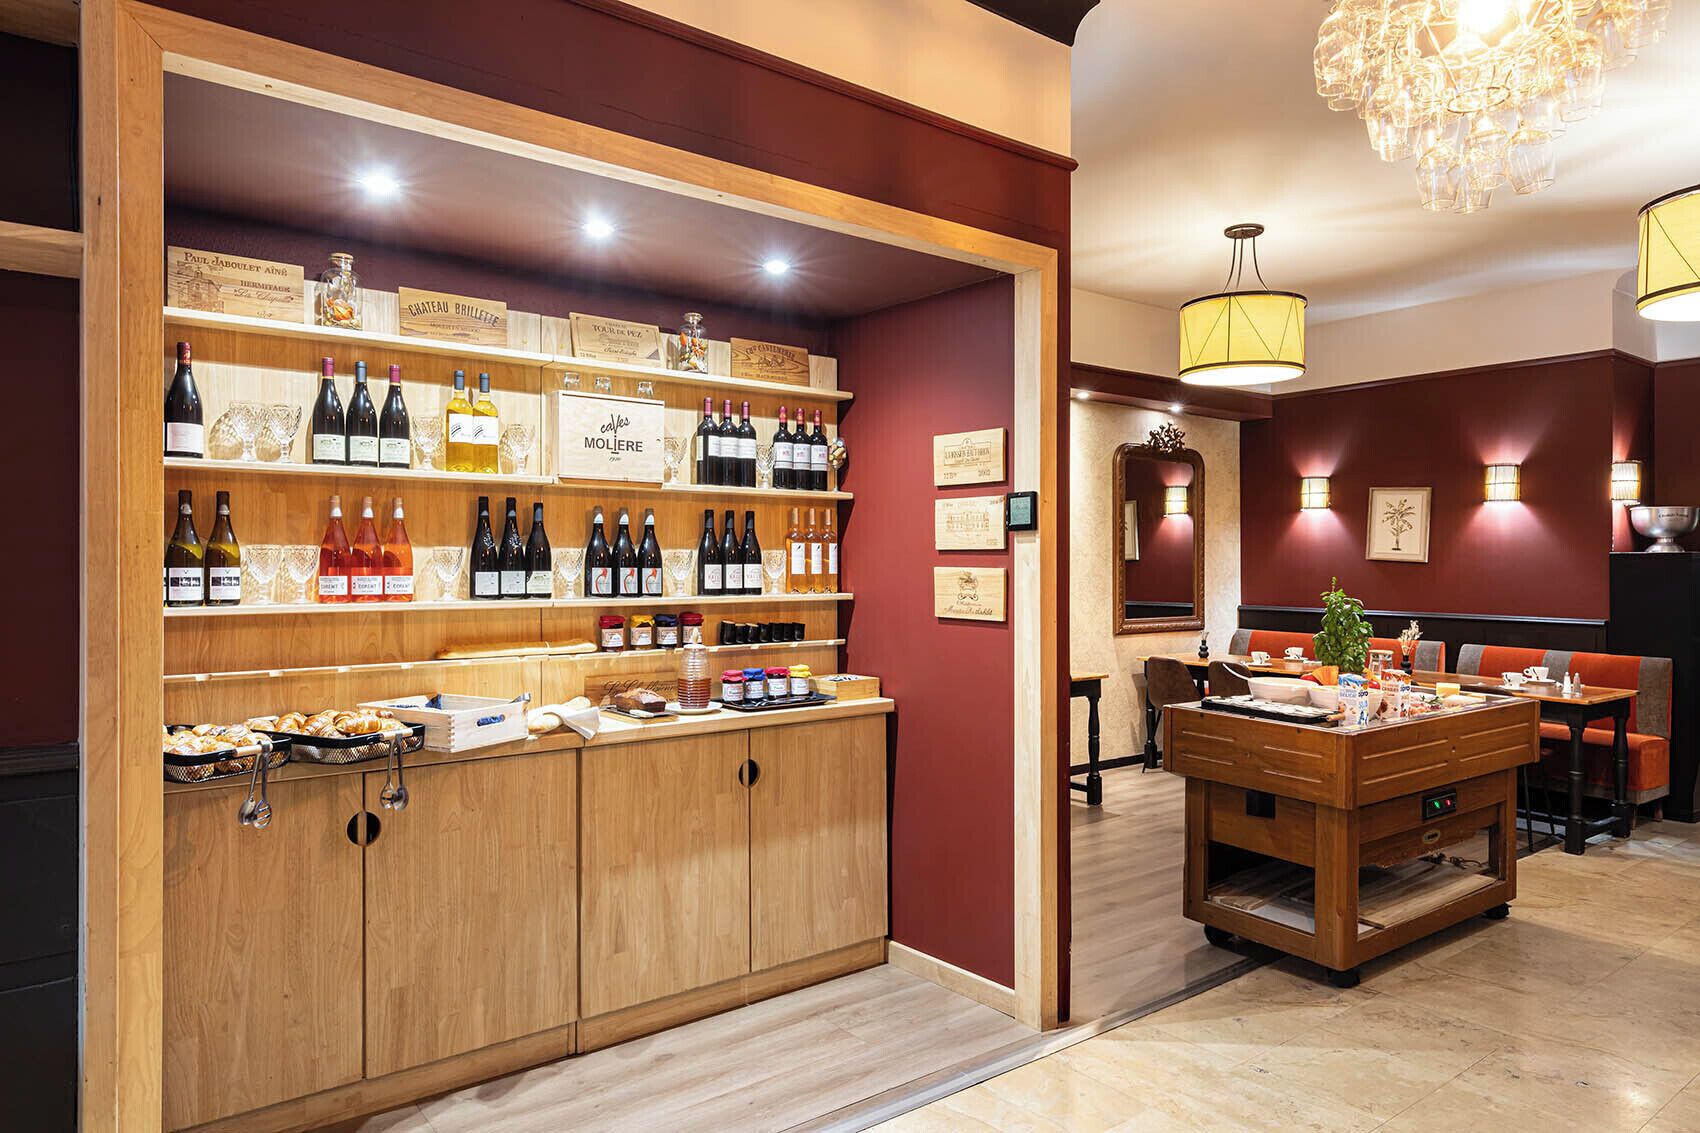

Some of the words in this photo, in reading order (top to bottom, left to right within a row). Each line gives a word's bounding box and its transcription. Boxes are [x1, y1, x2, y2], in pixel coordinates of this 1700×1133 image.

[184, 252, 209, 265] PAUL
[211, 256, 261, 273] JABOULET
[408, 301, 449, 317] CHATEAU
[455, 303, 500, 327] BRILLETTE
